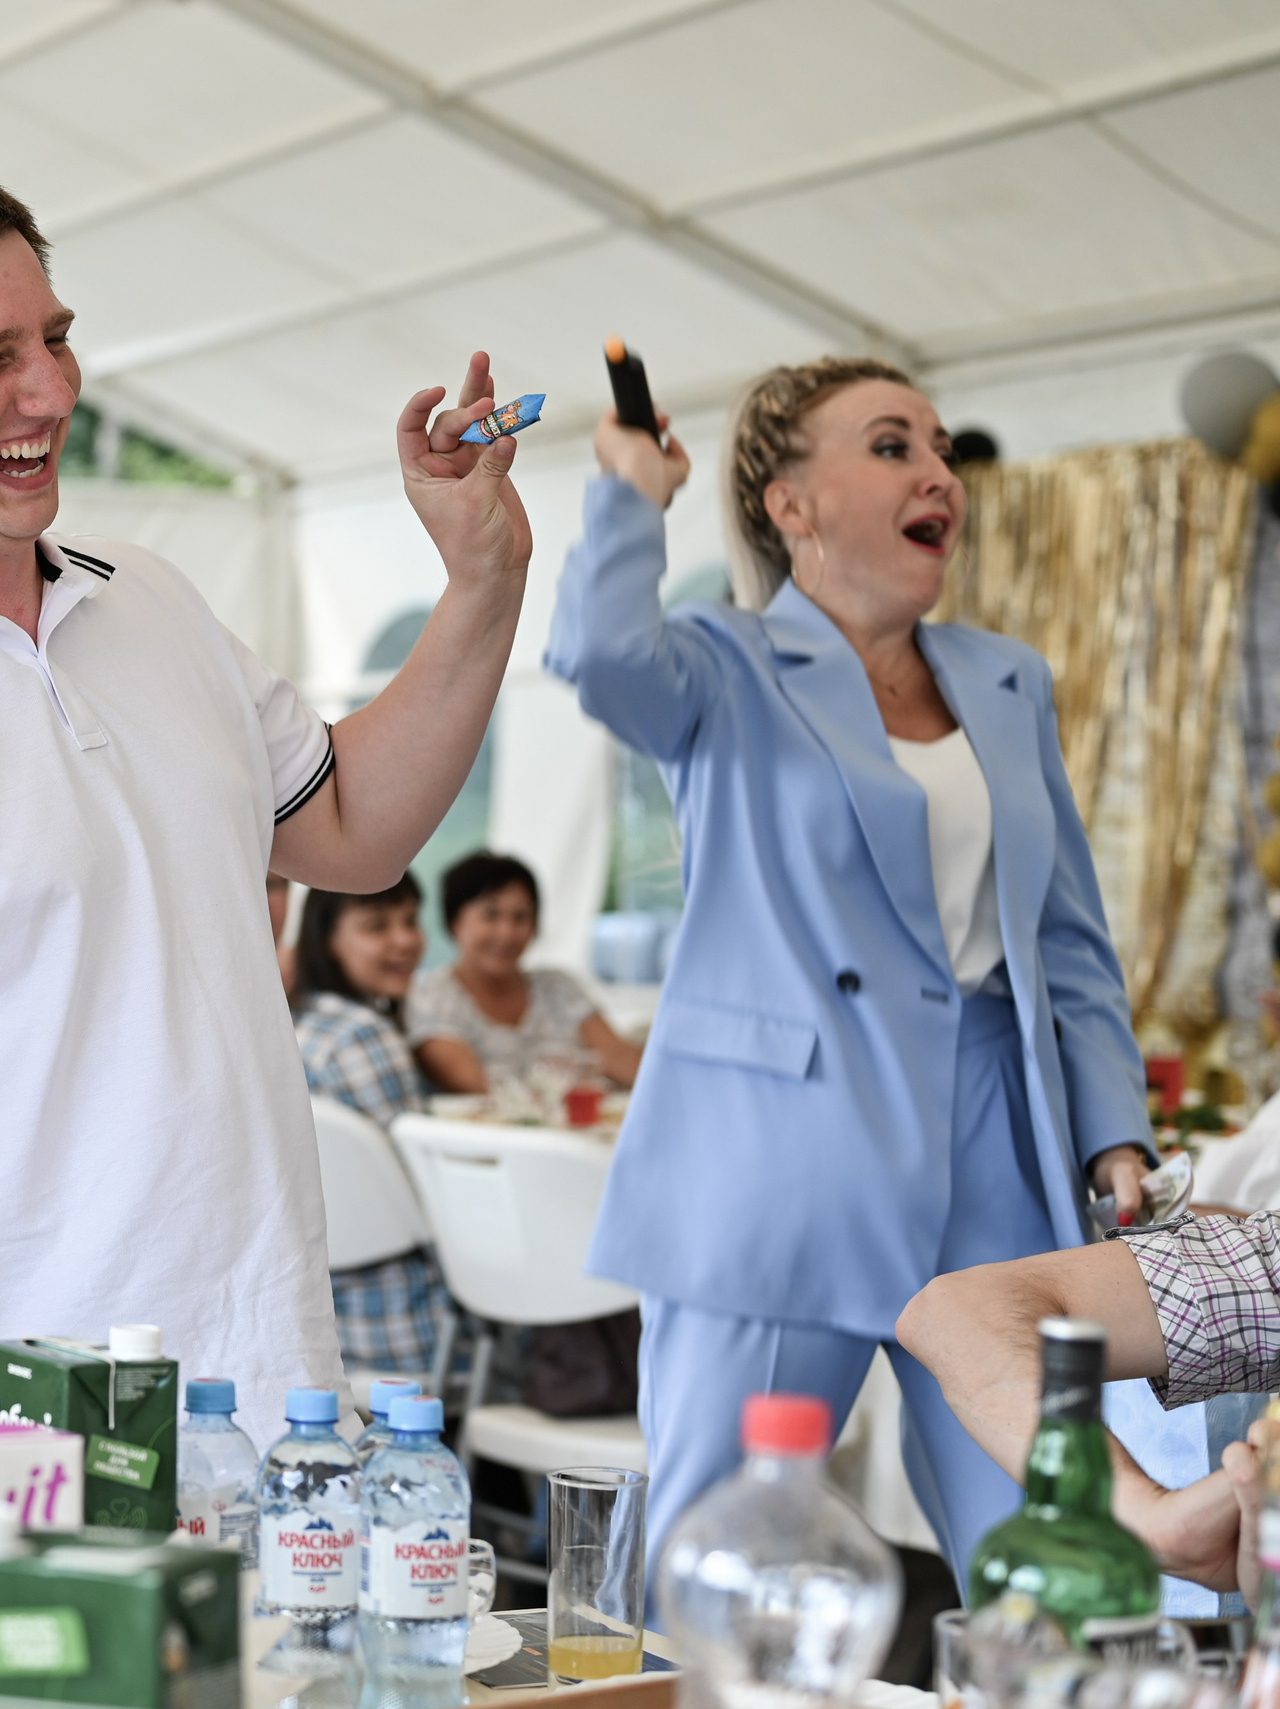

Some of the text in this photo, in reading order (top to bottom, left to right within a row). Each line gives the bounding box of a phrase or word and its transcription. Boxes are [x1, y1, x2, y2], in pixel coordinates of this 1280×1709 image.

[278, 1527, 355, 1549] КРАСНЫЙ
[394, 1538, 466, 1561] КРАСНЫЙ
[292, 1552, 343, 1568] КЛЮЧ
[410, 1563, 458, 1581] КЛЮЧ
